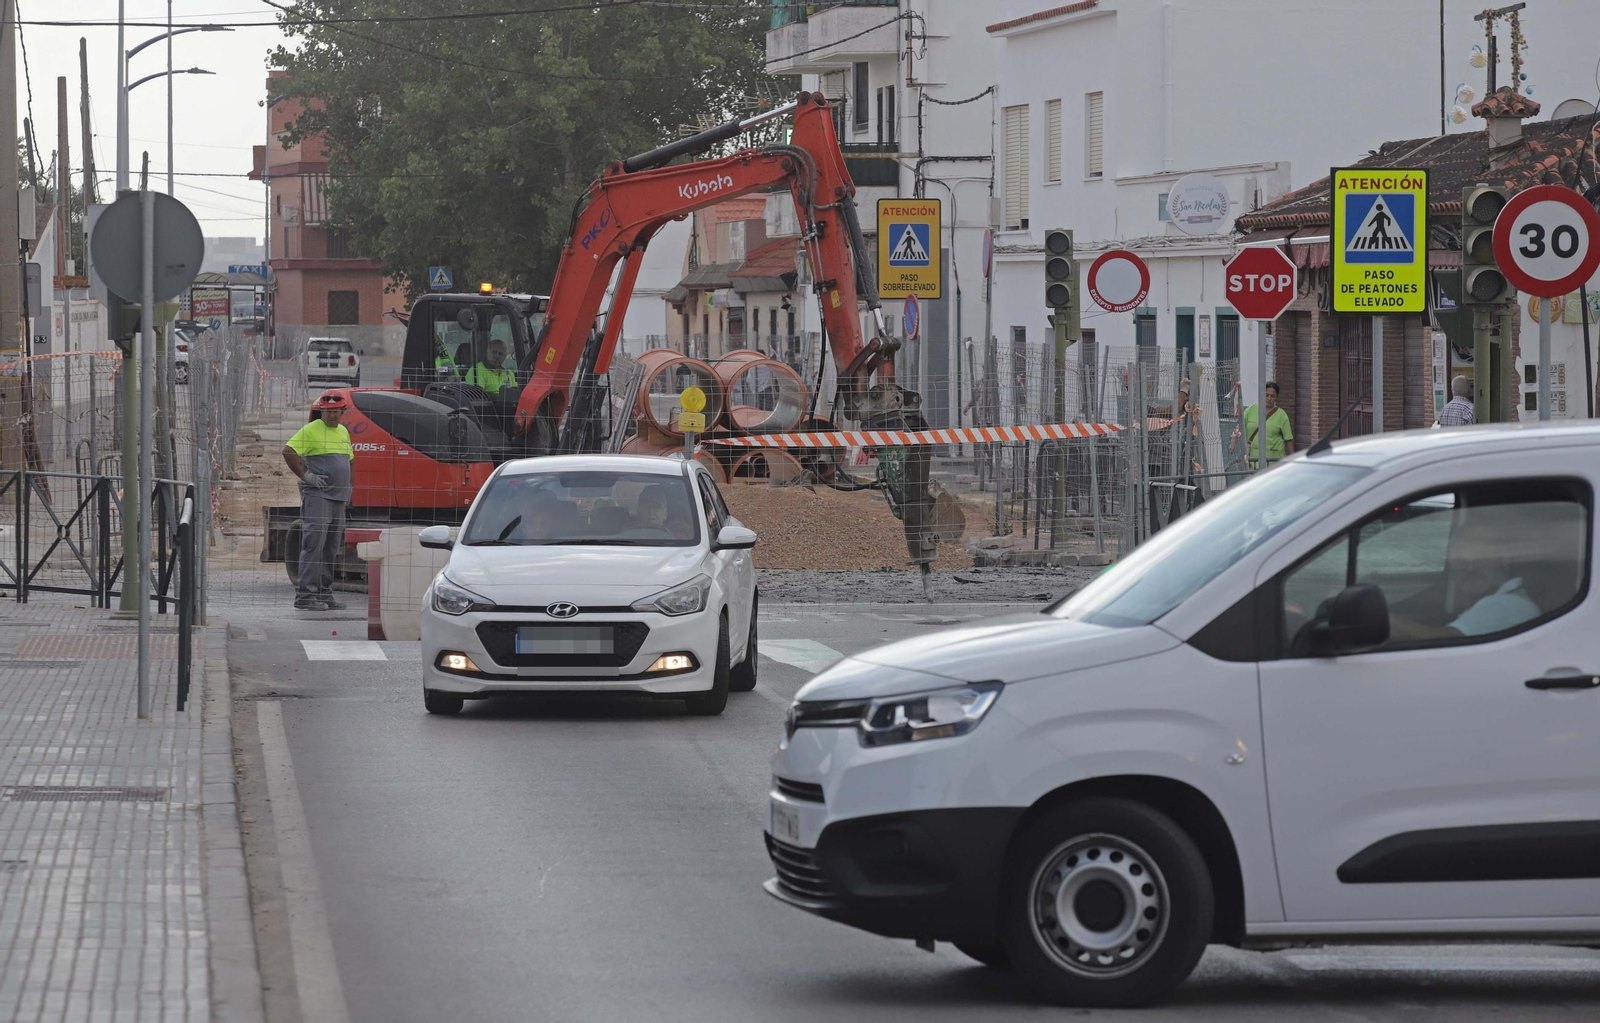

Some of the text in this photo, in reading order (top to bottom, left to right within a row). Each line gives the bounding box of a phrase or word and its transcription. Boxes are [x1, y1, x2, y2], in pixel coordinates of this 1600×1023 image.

[678, 174, 733, 199] Kubota
[1338, 174, 1423, 190] ATENCIÓN
[882, 205, 936, 216] ATENCIÓN
[1178, 198, 1221, 213] San Nicolás
[1519, 223, 1579, 258] 30
[233, 266, 263, 275] TAXI
[1364, 270, 1395, 280] PASO
[900, 274, 919, 282] PASO
[1228, 274, 1292, 293] STOP
[882, 283, 936, 291] SOBREELEVADO
[1341, 284, 1418, 293] DE PEATONES
[1090, 289, 1147, 312] EXCEPTO RESIDENTES
[1354, 297, 1405, 307] ELEVADO
